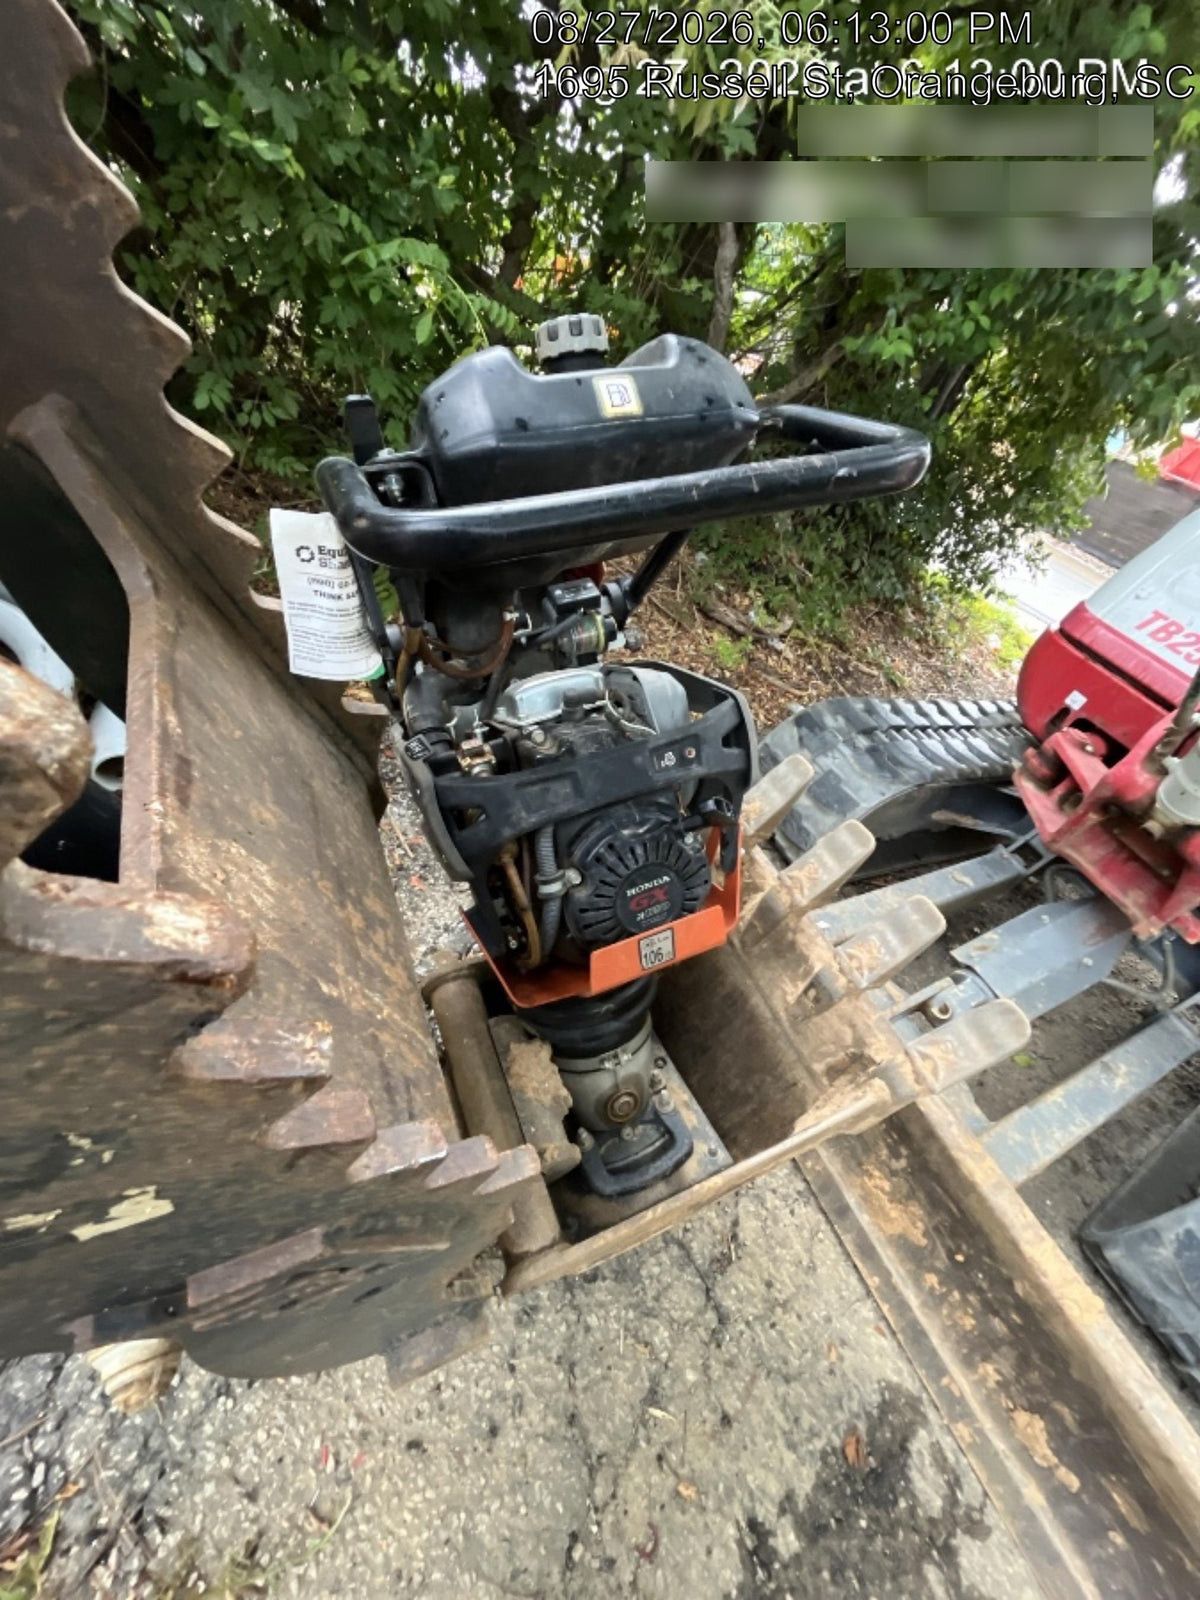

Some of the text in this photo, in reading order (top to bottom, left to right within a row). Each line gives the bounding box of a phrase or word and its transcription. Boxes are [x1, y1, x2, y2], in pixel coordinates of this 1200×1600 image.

[317, 545, 349, 559] Equ
[624, 875, 671, 897] HONDA
[643, 946, 664, 966] 106
